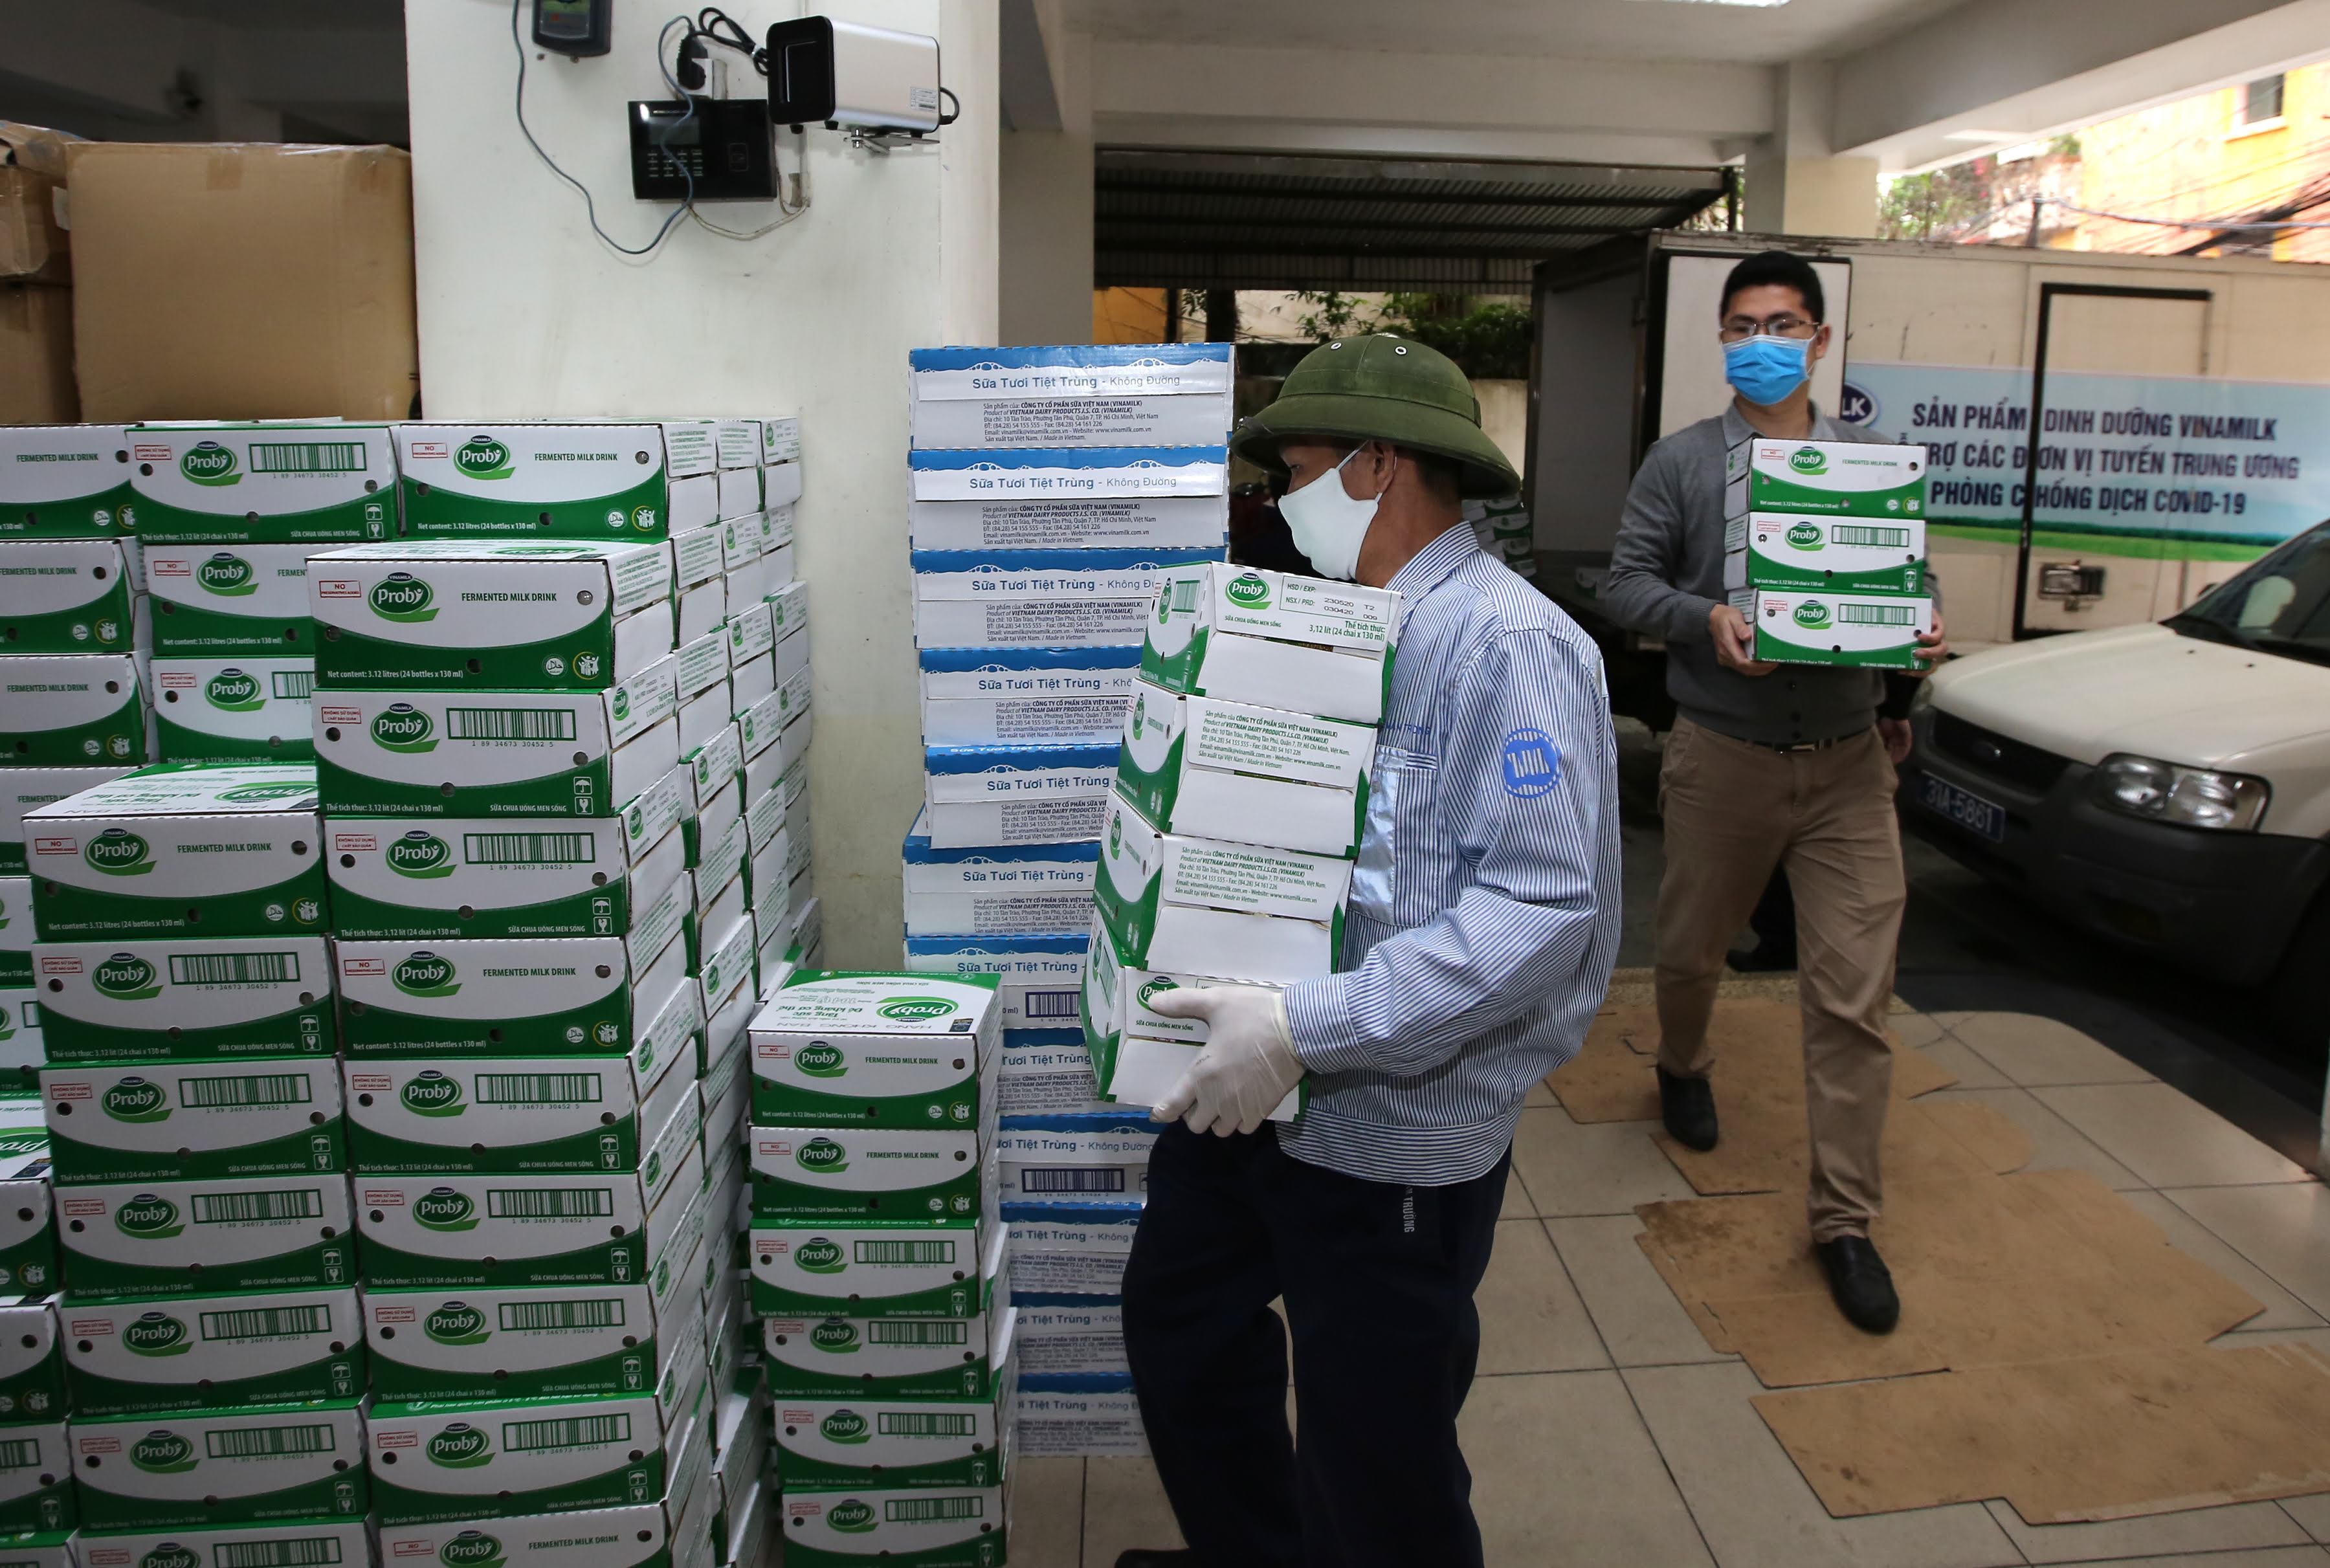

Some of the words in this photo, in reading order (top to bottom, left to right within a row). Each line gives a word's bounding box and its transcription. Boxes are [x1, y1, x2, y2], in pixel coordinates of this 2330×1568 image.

[972, 377, 996, 388] Sữa
[1001, 378, 1028, 388] Tươi
[1033, 377, 1055, 390] Tiệt
[1060, 377, 1096, 388] Trùng
[1111, 377, 1142, 387] Không
[1147, 375, 1181, 386] Đường
[1913, 395, 1957, 428] SẢN
[1964, 397, 2026, 430] PHẨM
[2044, 408, 2094, 433] DINH
[2102, 406, 2172, 437] DƯỠNG
[2179, 415, 2277, 440] VINAMILK
[188, 454, 227, 469] Proby
[462, 448, 502, 463] Proby
[1793, 454, 1821, 465] Proby
[1916, 441, 1957, 472] RỢ
[1963, 438, 2005, 468] CÁC
[2074, 448, 2092, 477] VỊ
[2100, 443, 2165, 474] TUYẾN
[2173, 452, 2237, 478] TRUNG
[2245, 453, 2300, 479] ƯƠNG
[970, 478, 993, 488] Sữa
[998, 478, 1025, 488] Tươi
[1029, 478, 1052, 489] Tiệt
[1056, 478, 1094, 489] Trùng
[1107, 478, 1139, 488] Không
[1143, 477, 1177, 487] Đường
[1930, 476, 2004, 506] PHÒNG
[2099, 487, 2147, 516] DỊCH
[2154, 489, 2245, 514] COVID-19
[1790, 529, 1817, 540] Proby
[205, 565, 245, 579] Proby
[972, 580, 997, 591] Sữa
[1001, 580, 1026, 590] Tươi
[1032, 580, 1054, 591] Tiệt
[1058, 580, 1094, 591] Trùng
[1107, 580, 1140, 590] Không
[1231, 582, 1263, 597] Proby
[378, 588, 424, 604] Proby
[461, 593, 508, 601] FERMENTED
[510, 593, 529, 601] MILK
[532, 593, 557, 601] DRINK
[1324, 597, 1354, 607] 230520
[1324, 606, 1353, 615] 030420
[1797, 608, 1825, 619] Proby
[1309, 625, 1323, 634] 3,12
[1332, 627, 1342, 637] (24
[1362, 631, 1373, 639] 130
[1375, 632, 1385, 641] ml)
[212, 681, 250, 696] Proby
[979, 679, 1002, 690] Sữa
[1006, 679, 1032, 690] Tươi
[1037, 678, 1060, 691] Tiệt
[1064, 678, 1100, 690] Trùng
[379, 718, 423, 735] Proby
[987, 780, 1011, 791] Sữa
[1015, 780, 1042, 790] Tươi
[1046, 778, 1069, 790] Tiệt
[1073, 777, 1109, 788] Trùng
[94, 842, 139, 858] Proby
[395, 845, 439, 861] Proby
[963, 872, 986, 881] Sữa
[990, 872, 1017, 881] Tươi
[1021, 871, 1044, 883] Tiệt
[1048, 871, 1083, 881] Trùng
[101, 966, 145, 982] Proby
[401, 965, 446, 982] Proby
[958, 963, 980, 972] Sữa
[1015, 962, 1038, 973] Tiệt
[1041, 962, 1077, 973] Trùng
[890, 1003, 946, 1016] Proby
[802, 1051, 836, 1066] Proby
[1030, 1055, 1053, 1066] Tiệt
[1056, 1054, 1091, 1065] Trùng
[110, 1091, 155, 1108] Proby
[409, 1084, 451, 1100] Proby
[1016, 1140, 1037, 1151] Tiệt
[1042, 1140, 1076, 1152] Trùng
[1089, 1142, 1119, 1152] Không
[803, 1148, 838, 1162] Proby
[421, 1199, 463, 1215] Proby
[124, 1207, 167, 1223] Proby
[1028, 1231, 1048, 1241] Tiệt
[1052, 1231, 1086, 1242] Trùng
[1098, 1233, 1128, 1242] Không
[801, 1248, 836, 1262] Proby
[435, 1435, 478, 1453] Proby
